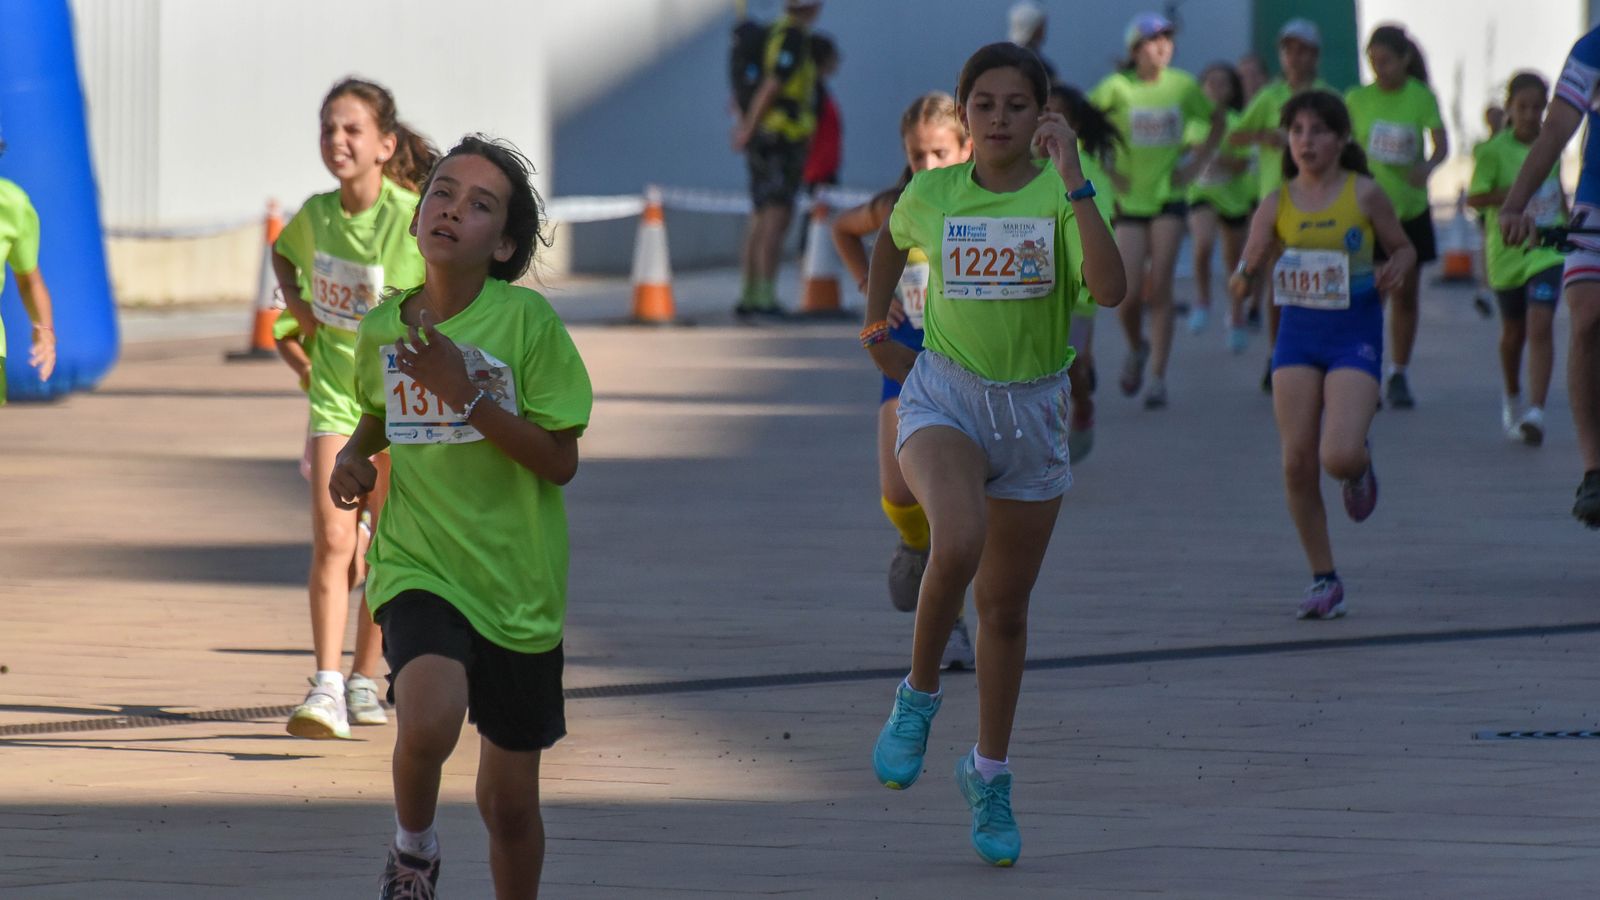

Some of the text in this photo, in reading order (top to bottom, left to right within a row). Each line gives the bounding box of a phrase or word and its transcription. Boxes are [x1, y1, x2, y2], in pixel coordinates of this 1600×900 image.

[948, 224, 967, 237] XXI
[1003, 223, 1035, 231] MARTINA
[950, 246, 1015, 276] 1222
[1278, 271, 1320, 292] 1181
[314, 278, 352, 310] 1352
